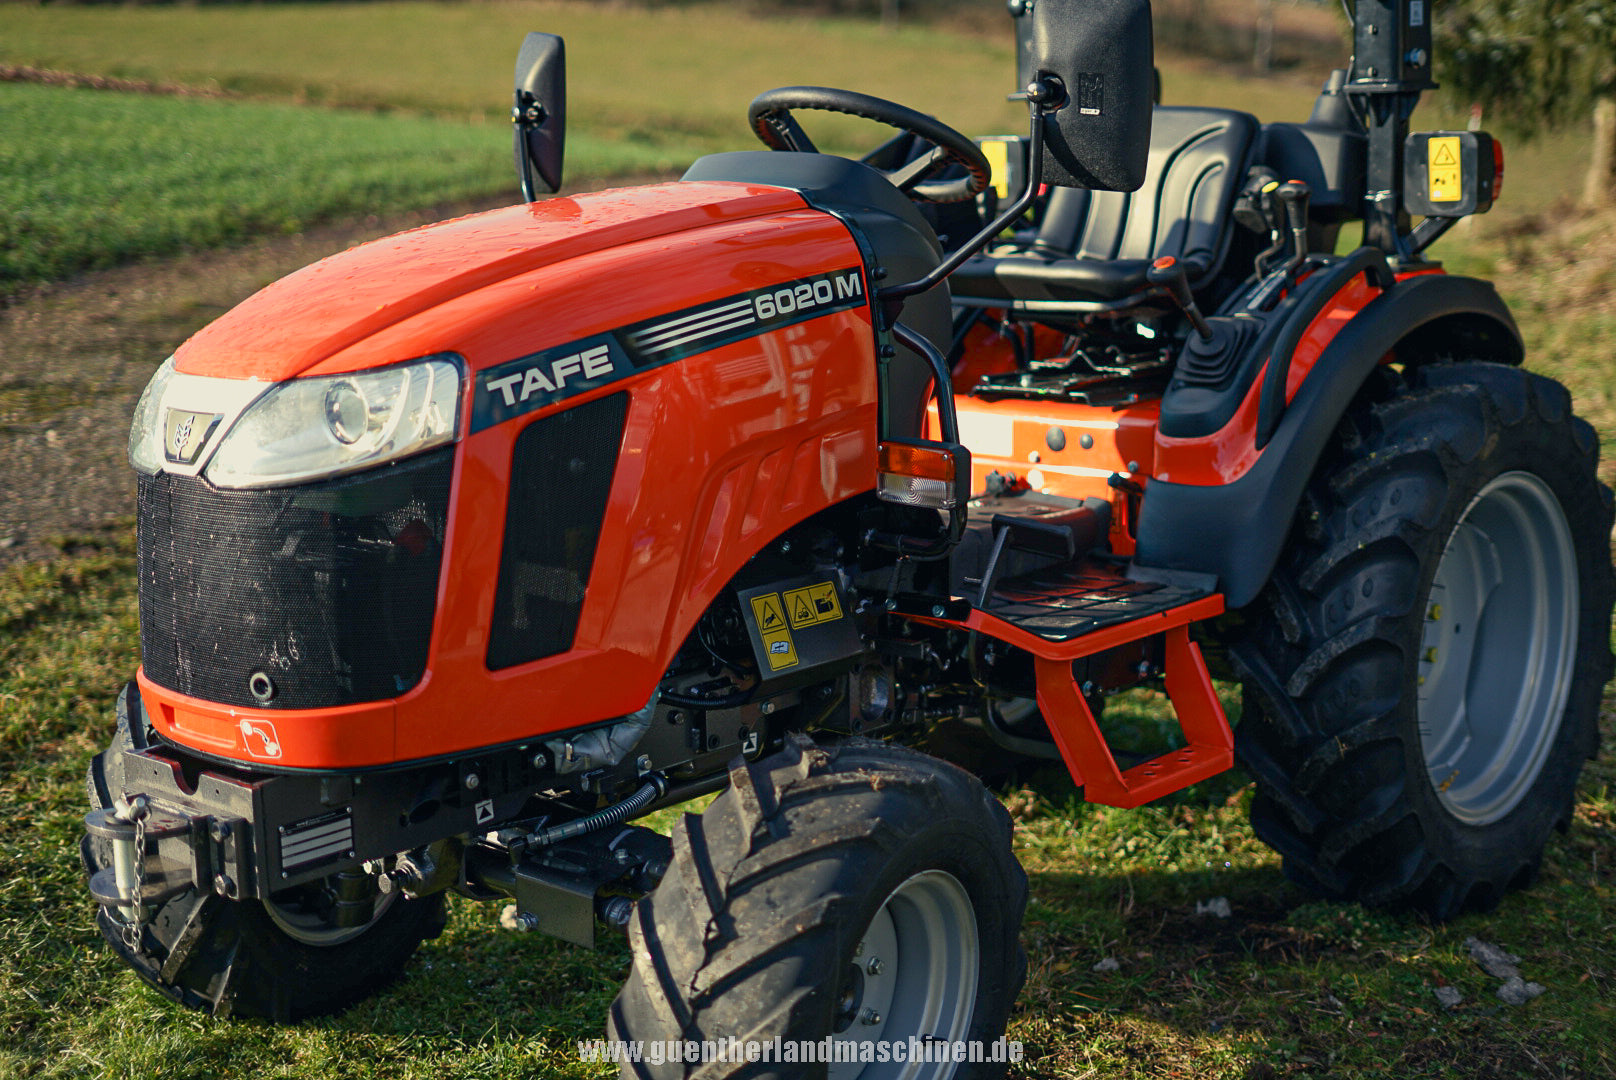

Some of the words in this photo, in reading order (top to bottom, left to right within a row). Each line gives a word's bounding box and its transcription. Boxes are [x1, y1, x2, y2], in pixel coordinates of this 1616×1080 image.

[486, 344, 614, 406] TAFE
[755, 280, 833, 319] 6020
[835, 273, 862, 299] M
